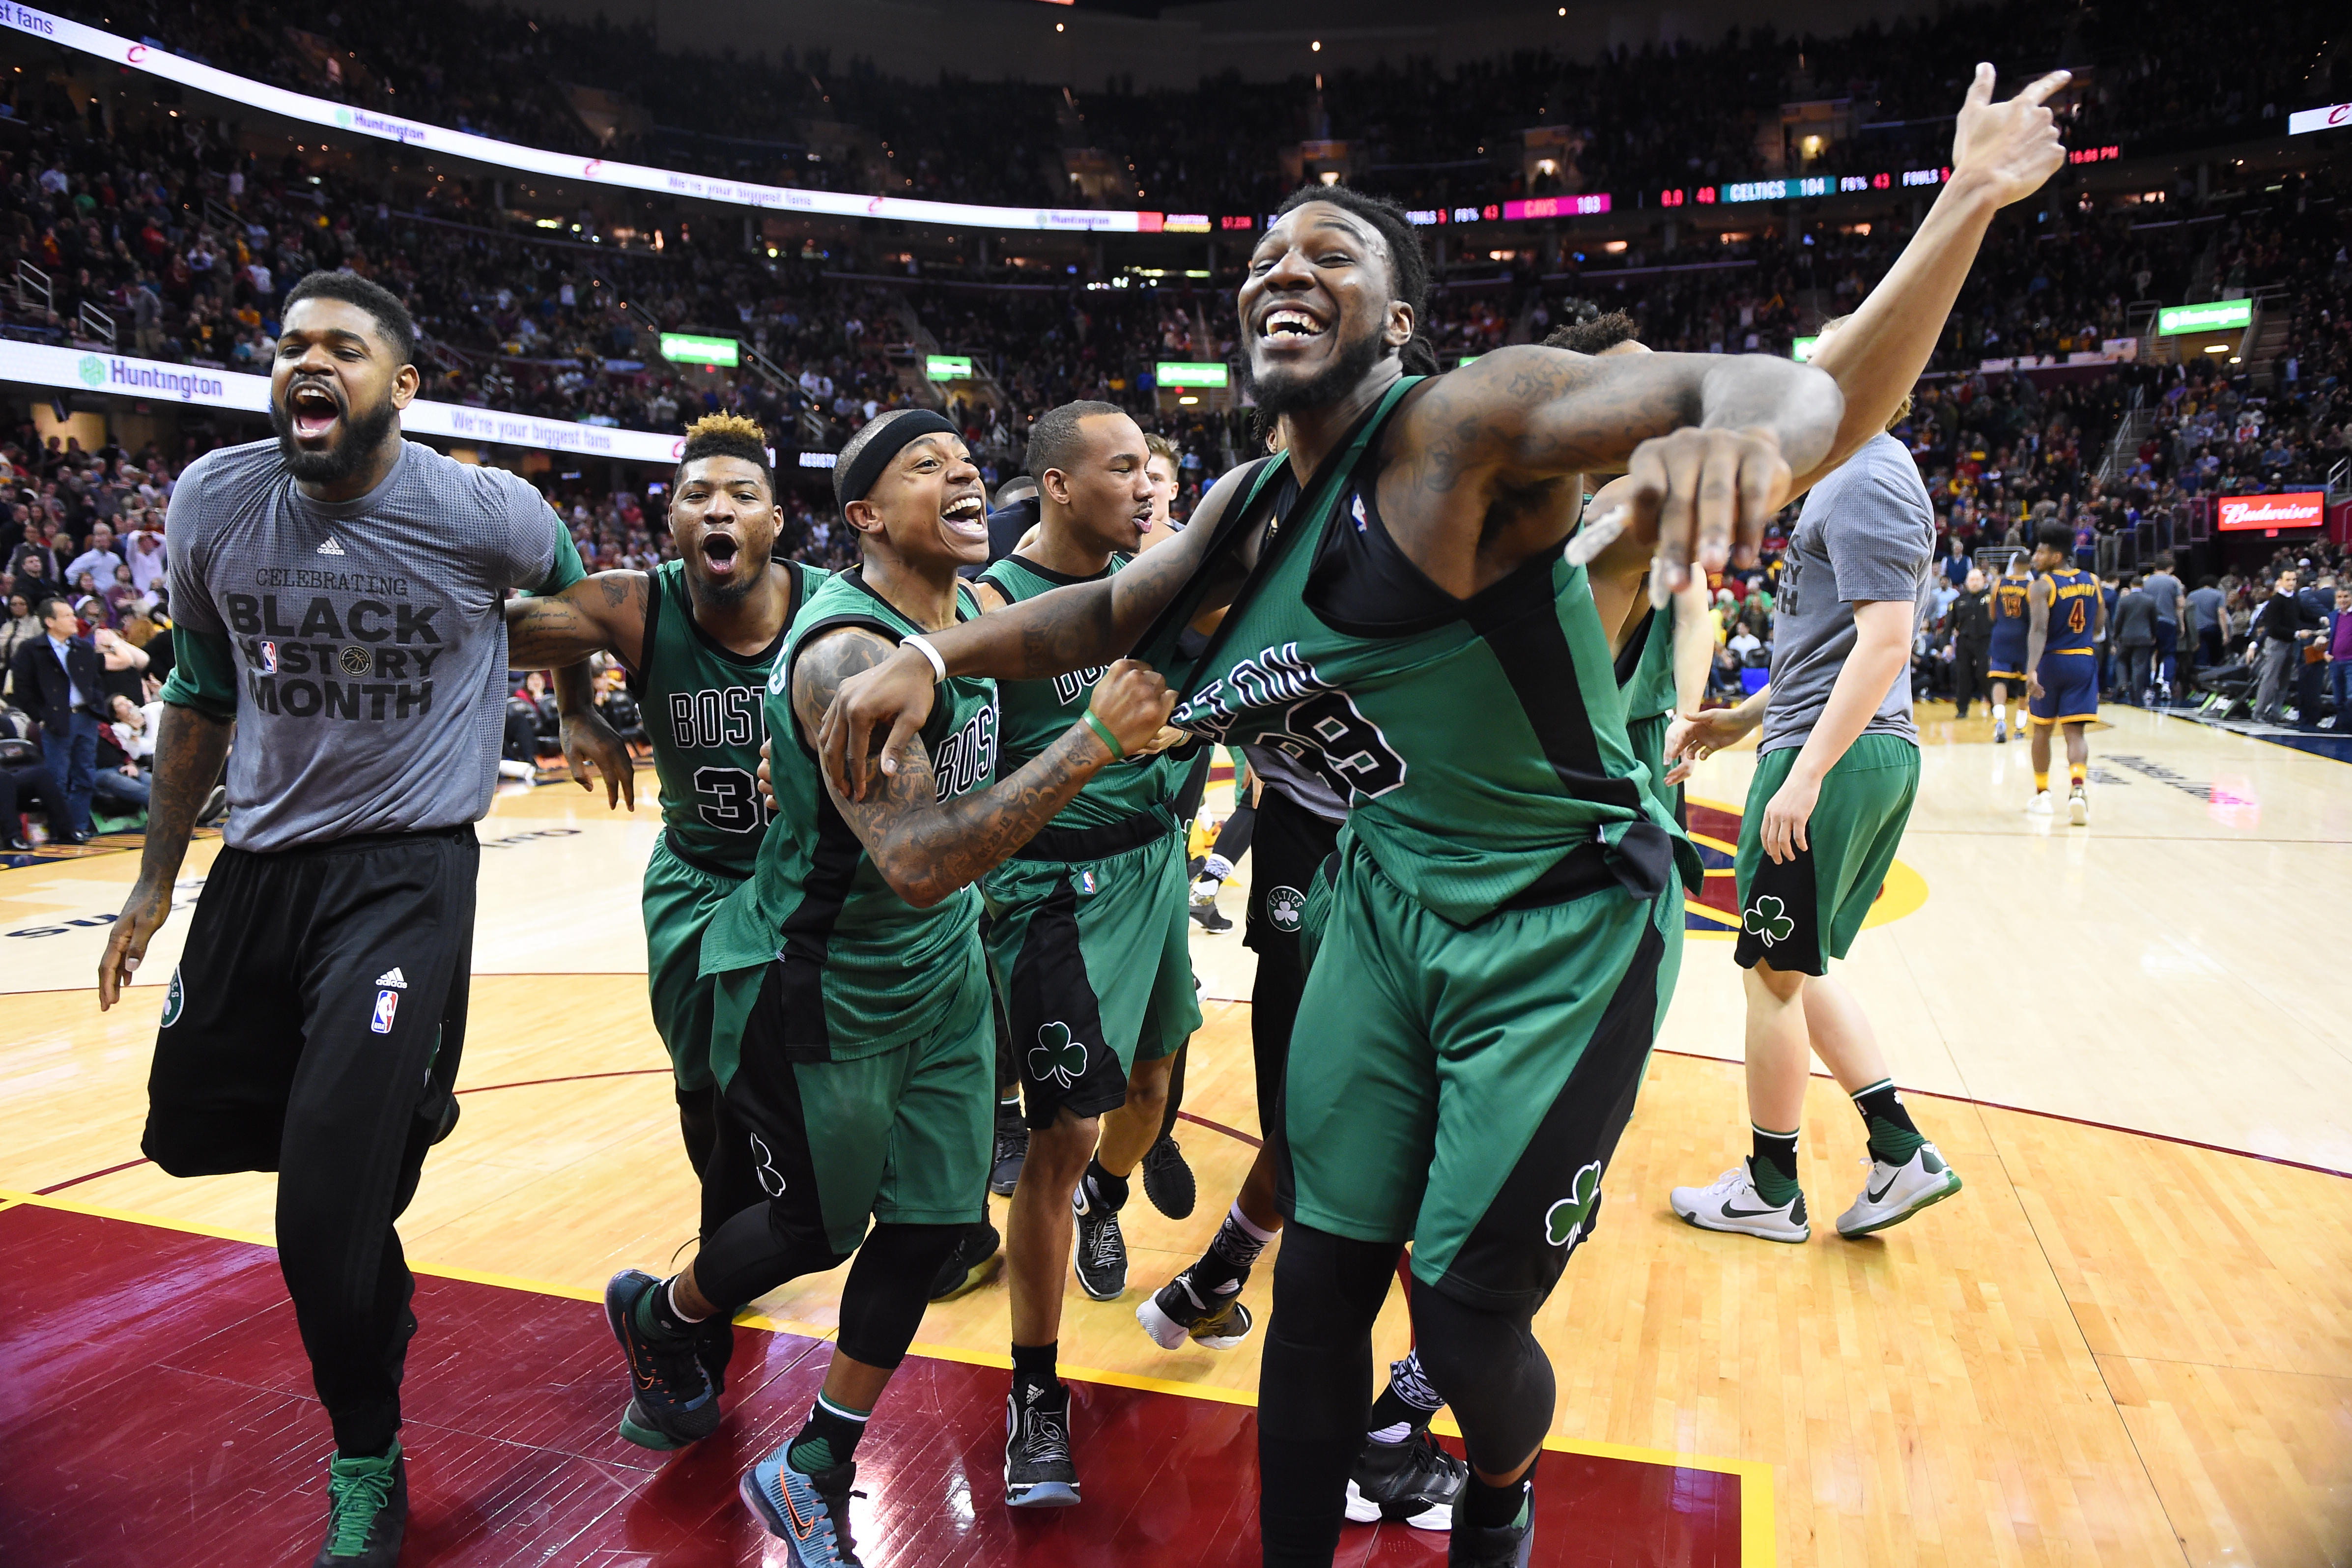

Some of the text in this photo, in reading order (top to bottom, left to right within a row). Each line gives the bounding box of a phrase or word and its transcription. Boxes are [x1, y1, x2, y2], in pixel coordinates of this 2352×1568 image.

[17, 7, 53, 34] fans
[1729, 180, 1786, 202] CELTICS
[1800, 177, 1825, 197] 104
[1903, 169, 1939, 187] FOULS
[1524, 198, 1558, 218] CAVS
[1577, 196, 1601, 214] 103
[112, 359, 222, 399] Huntington
[452, 411, 611, 449] We're your biggest fans
[2221, 503, 2319, 524] Budweiser
[316, 547, 344, 556] adidas
[255, 568, 408, 596] CELEBRATING
[226, 593, 443, 645] BLACK
[2068, 598, 2086, 634] 4
[248, 667, 434, 721] MONTH
[1269, 890, 1303, 908] CELTICS
[375, 978, 408, 989] adidas
[1026, 1388, 1045, 1404] adidas
